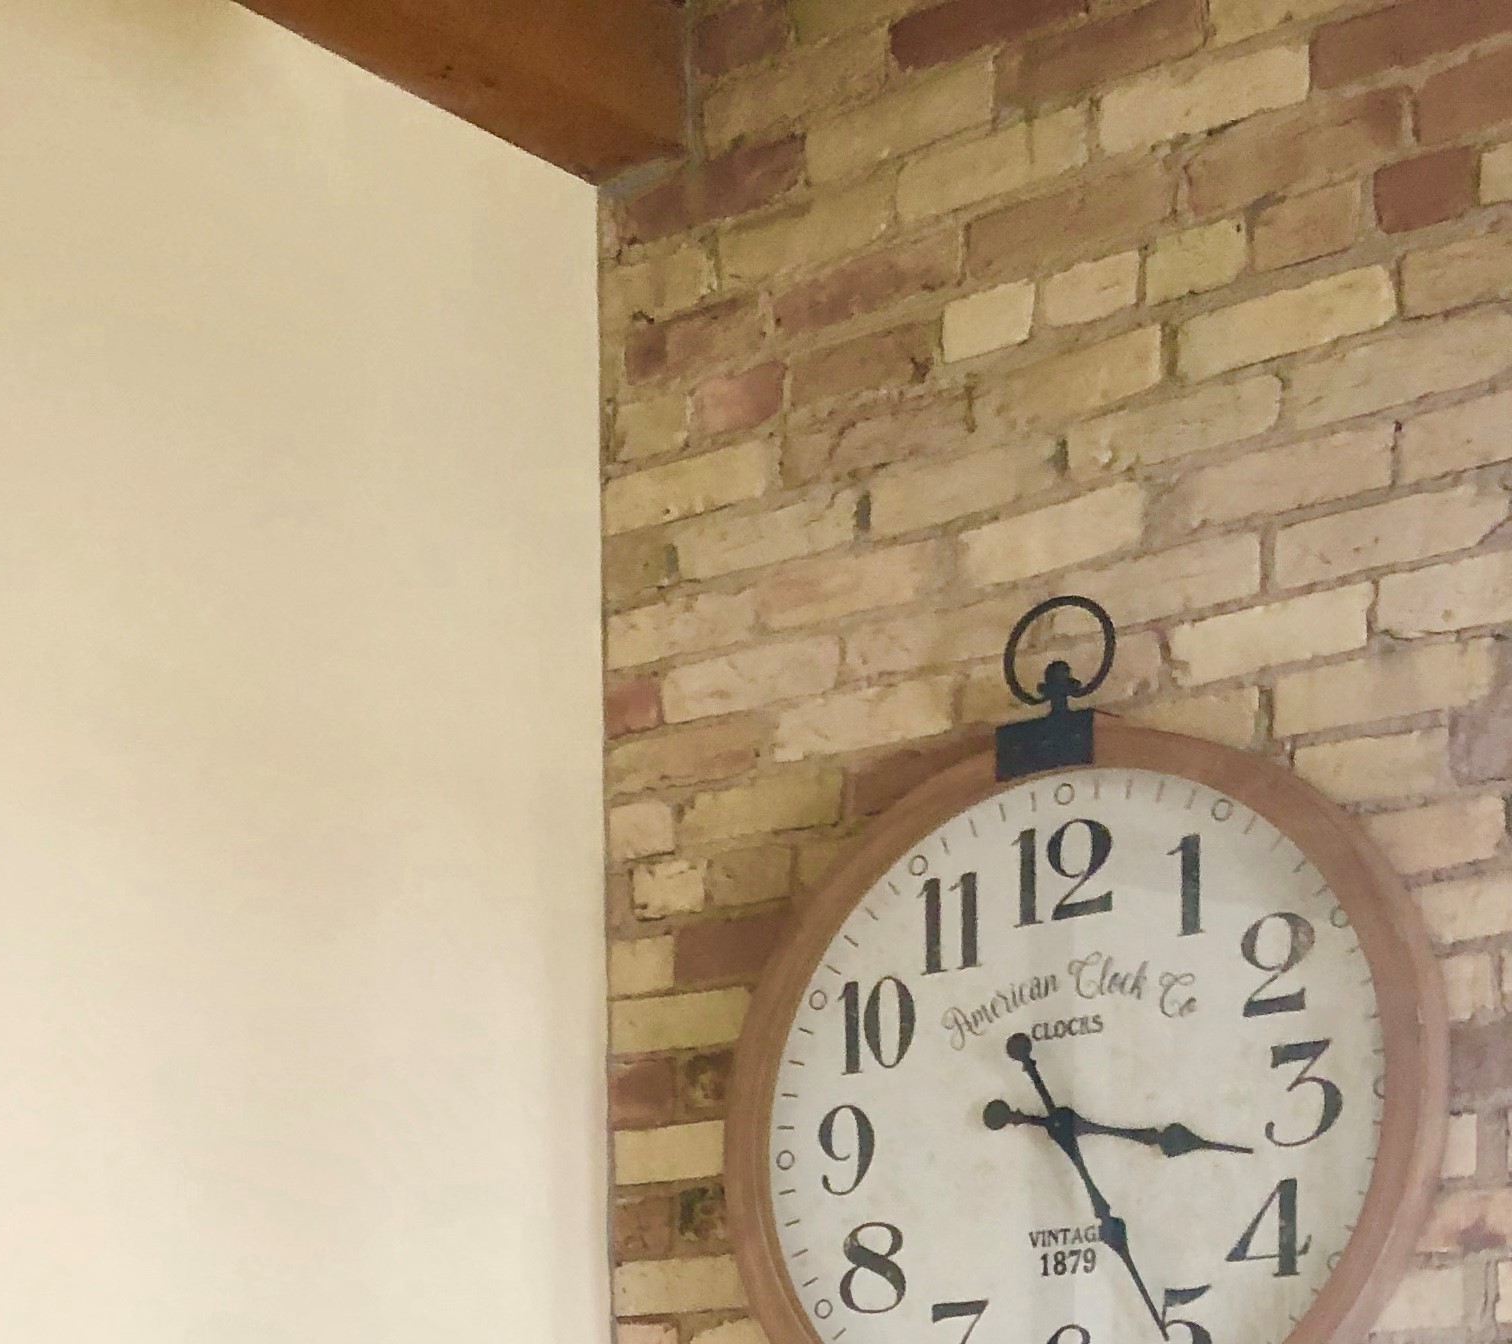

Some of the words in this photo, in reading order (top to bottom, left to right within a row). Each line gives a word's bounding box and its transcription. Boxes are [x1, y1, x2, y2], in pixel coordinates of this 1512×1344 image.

[919, 871, 981, 975] 11
[1010, 818, 1114, 928] 12
[1166, 834, 1205, 937] 1
[941, 974, 1059, 1051] American
[1067, 951, 1150, 1000] Clock
[1240, 912, 1315, 1018] 2
[840, 975, 915, 1076] 10
[1264, 1038, 1343, 1148] 3
[818, 1105, 875, 1197] 9
[839, 1221, 907, 1314] 8
[1029, 1225, 1102, 1249] VINTAG
[1040, 1247, 1097, 1277] 1879
[1225, 1178, 1312, 1278] 4
